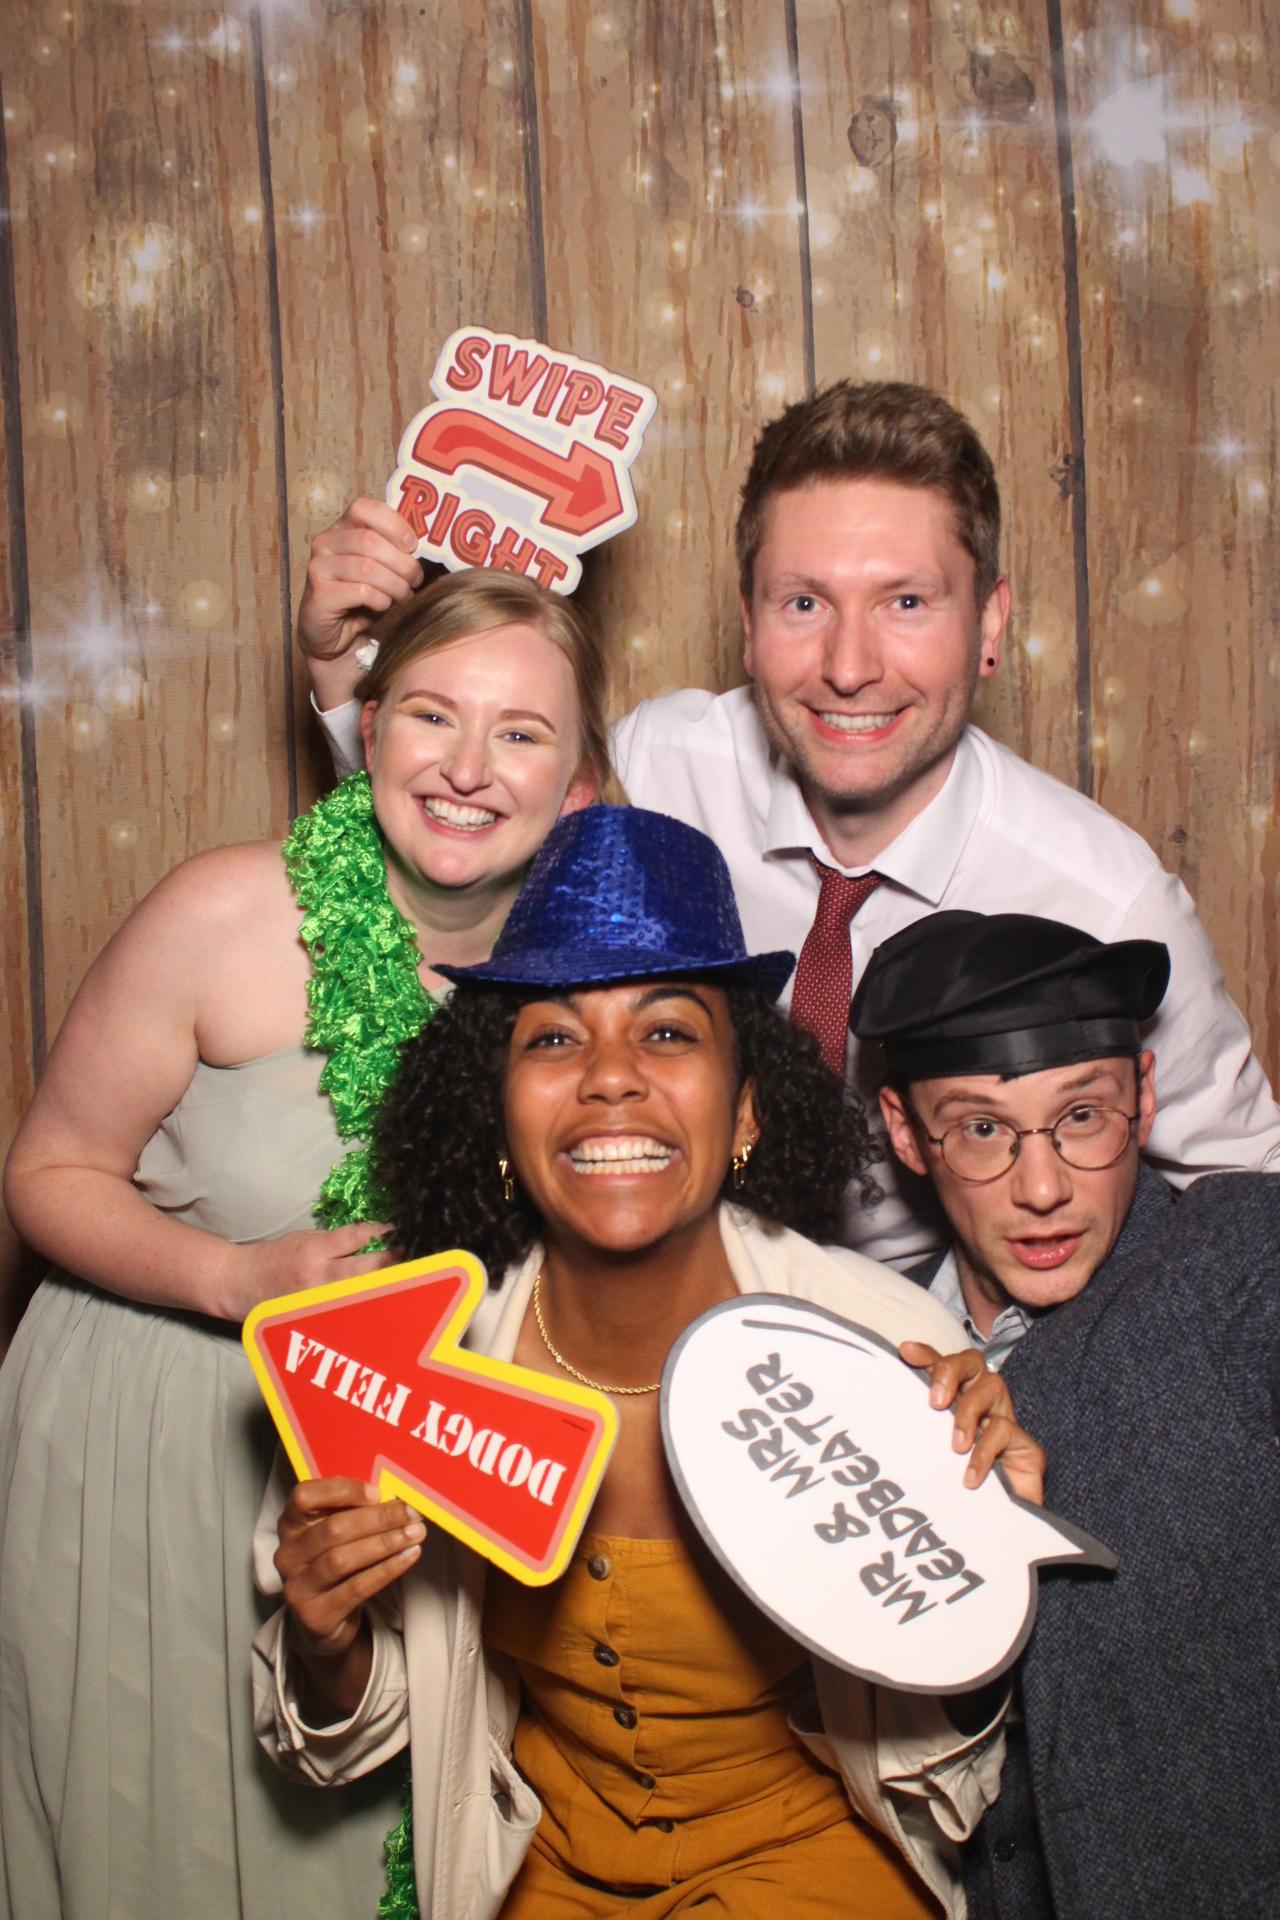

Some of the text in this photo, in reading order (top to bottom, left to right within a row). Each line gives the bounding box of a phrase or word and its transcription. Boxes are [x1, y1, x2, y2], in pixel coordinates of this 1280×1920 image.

[446, 336, 643, 451] SWIPE
[397, 475, 569, 590] RIGHT
[284, 1330, 567, 1506] DODGY FELLA
[746, 1352, 985, 1605] LEADBEATER
[721, 1408, 938, 1625] MR & MRS
